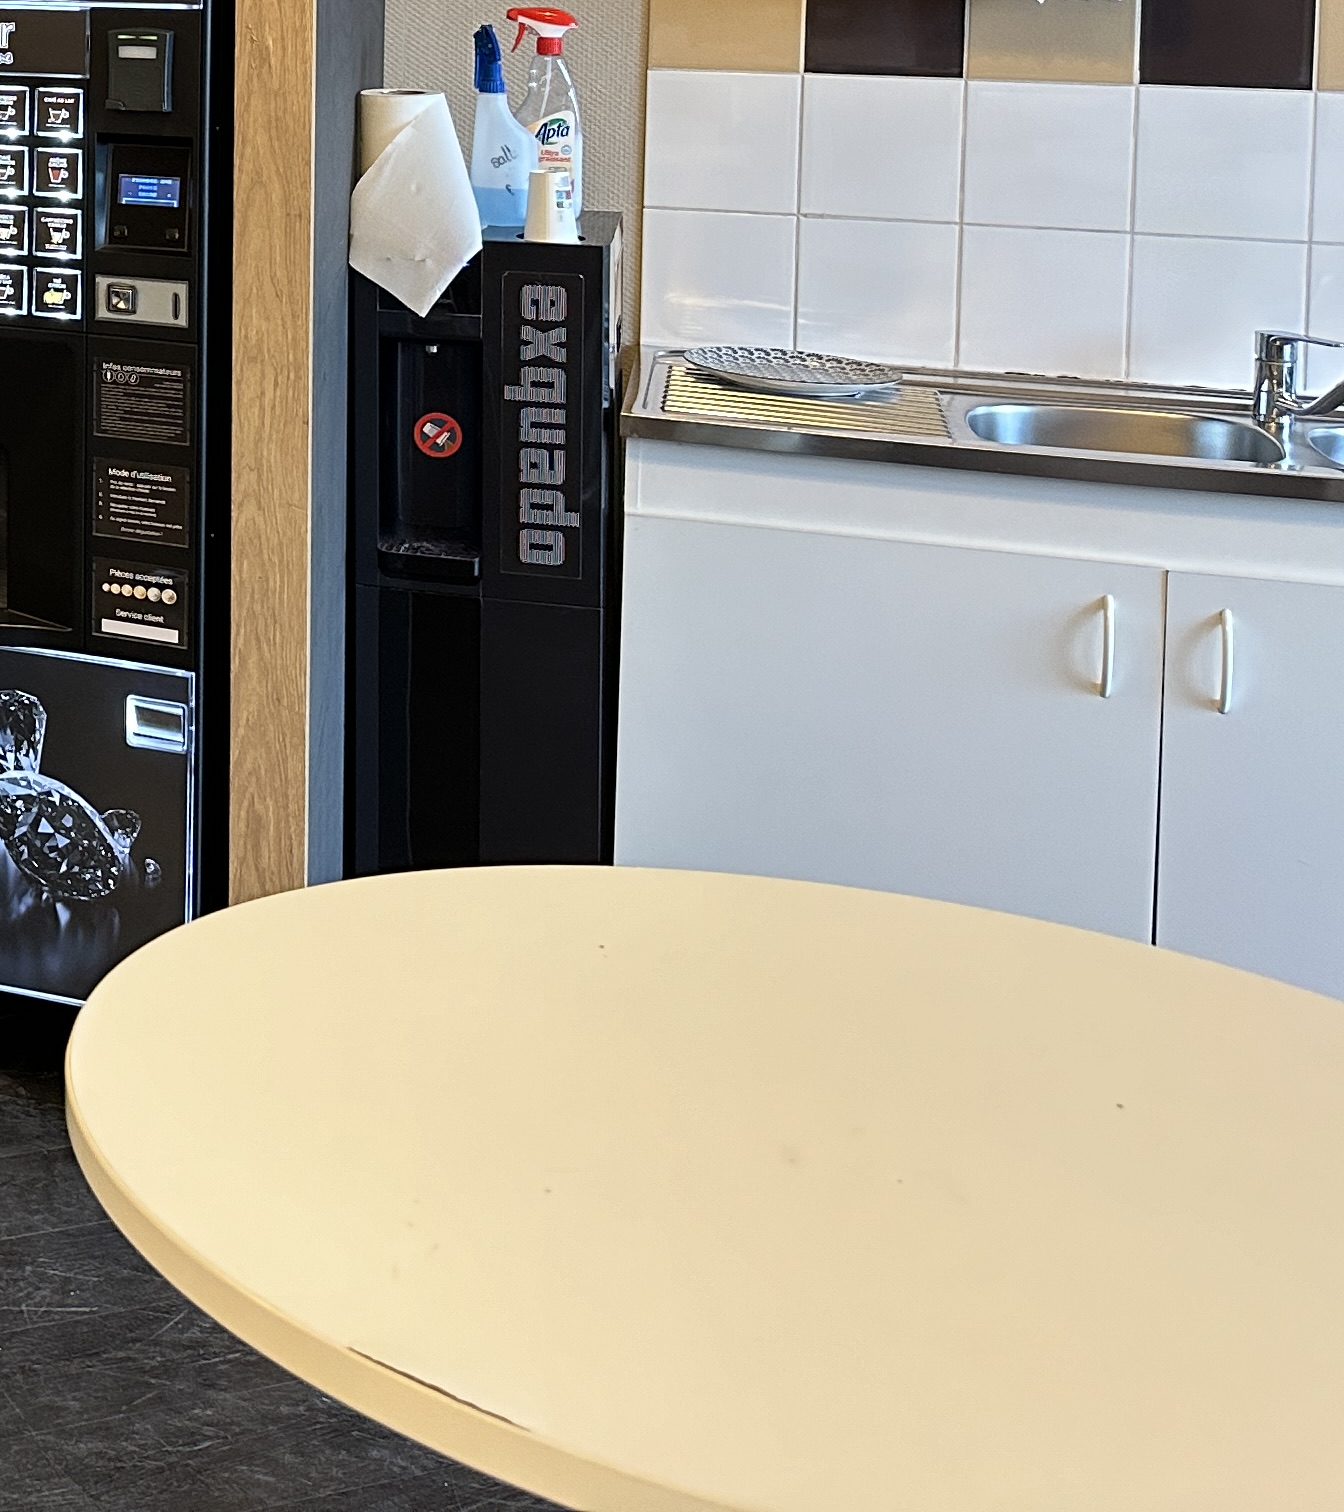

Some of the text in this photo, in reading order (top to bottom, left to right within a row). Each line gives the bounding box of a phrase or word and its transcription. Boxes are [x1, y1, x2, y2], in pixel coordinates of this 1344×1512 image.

[535, 122, 570, 146] Apta
[504, 284, 580, 566] exquado
[108, 468, 172, 482] Mode d'utilisation
[109, 569, 173, 585] Pièces acceptées
[115, 609, 164, 623] Service client
